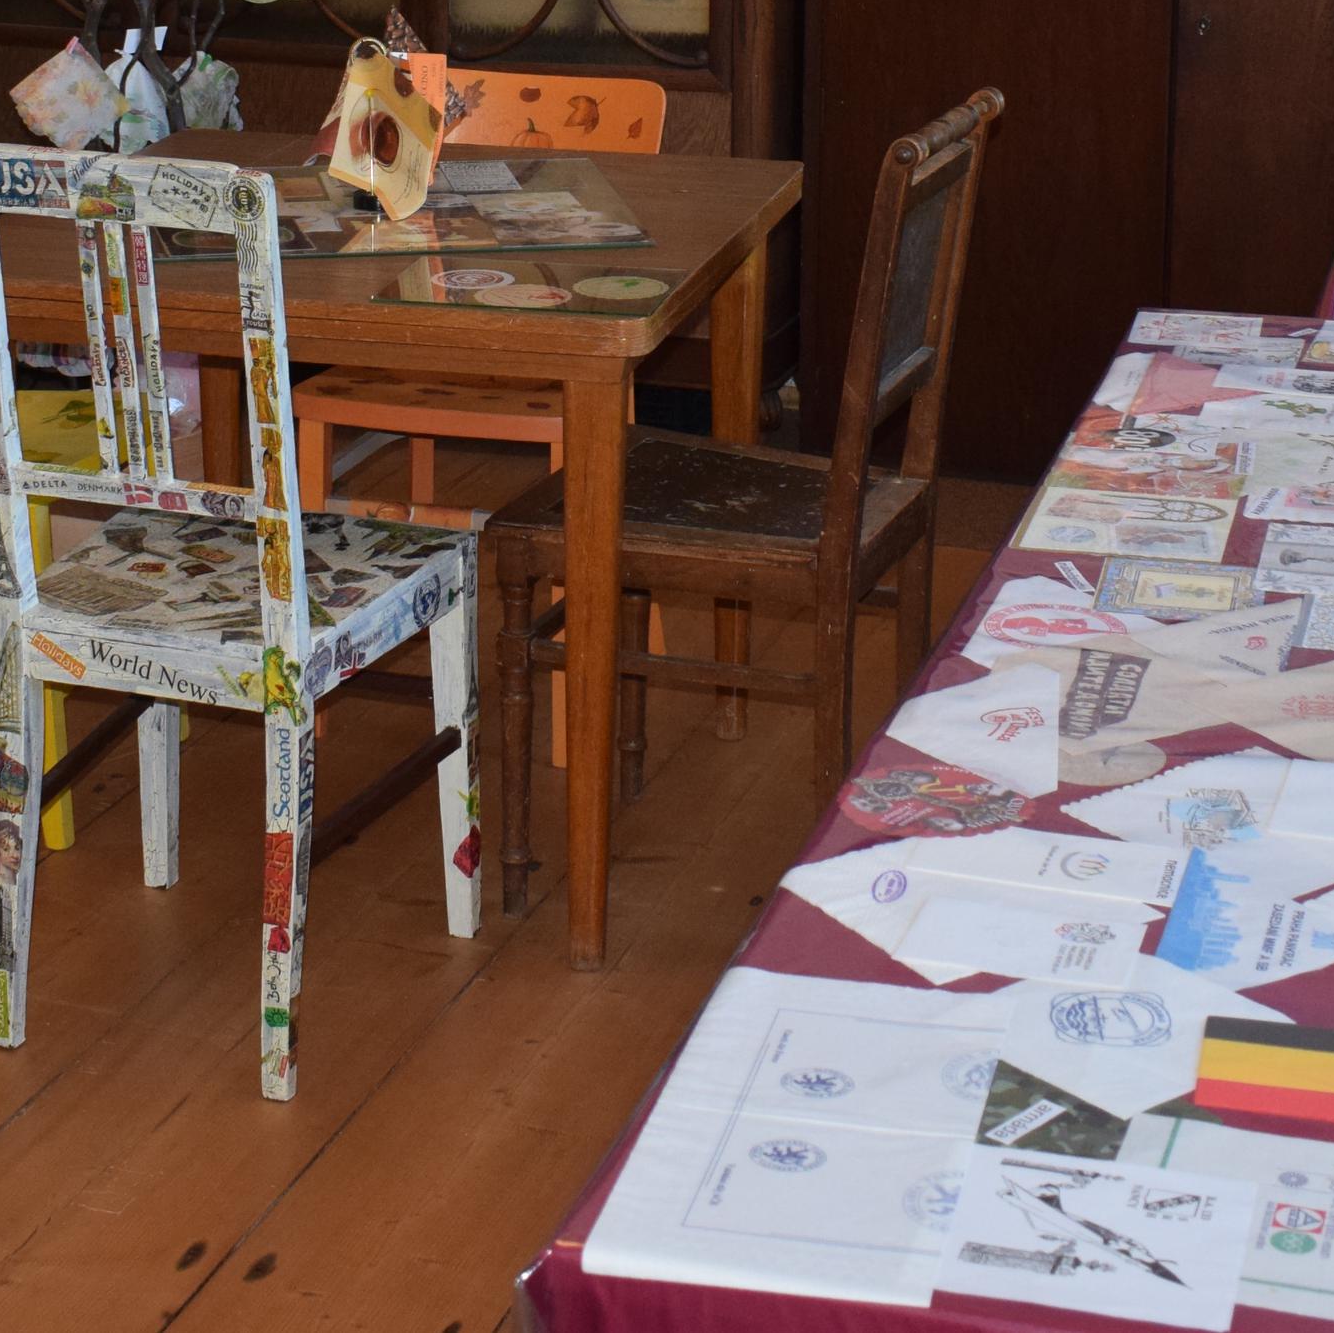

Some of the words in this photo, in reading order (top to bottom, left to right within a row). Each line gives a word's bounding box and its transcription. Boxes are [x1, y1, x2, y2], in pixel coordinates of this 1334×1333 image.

[32, 480, 68, 489] DELTA
[77, 481, 124, 496] DENMARK
[31, 633, 85, 678] Holidays
[87, 638, 152, 682] World
[156, 663, 220, 706] News
[272, 727, 292, 820] Scotland
[1155, 859, 1178, 899] nemocnice
[994, 1102, 1053, 1141] armáda
